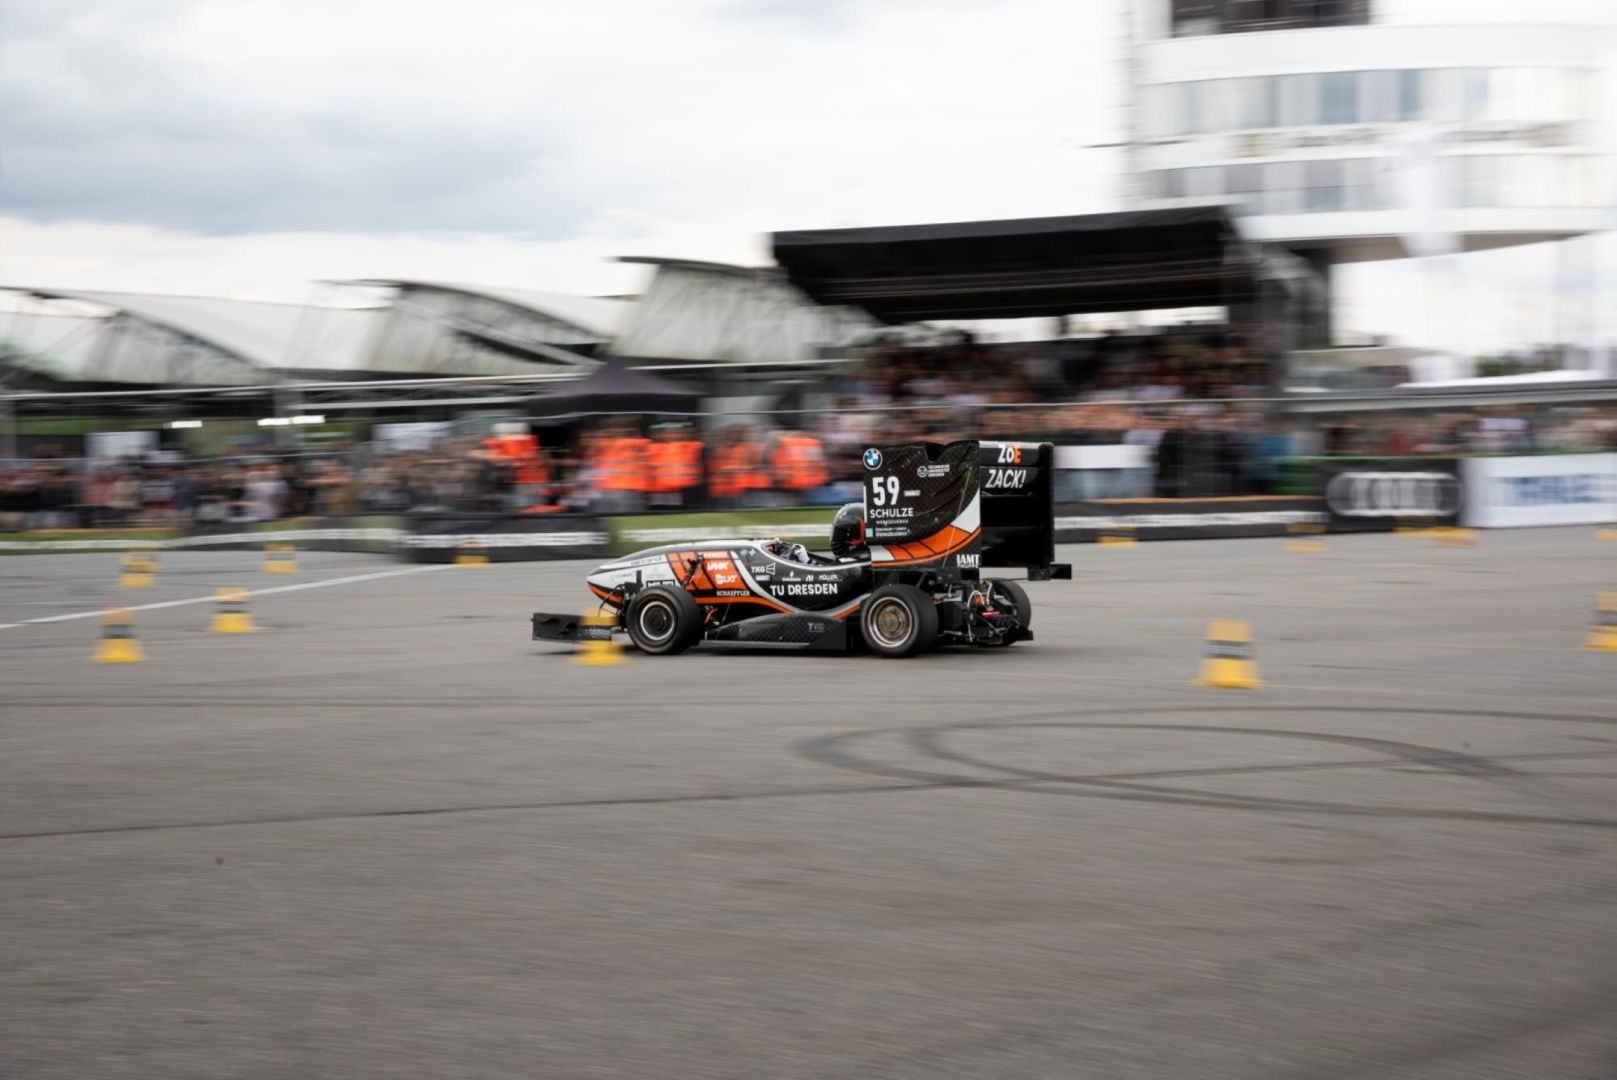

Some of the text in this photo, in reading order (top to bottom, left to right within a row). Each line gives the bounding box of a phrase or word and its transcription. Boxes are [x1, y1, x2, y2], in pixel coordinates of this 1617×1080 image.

[985, 469, 1027, 489] ZACK!
[872, 476, 900, 506] 59
[869, 507, 914, 519] SCHULZE
[770, 583, 838, 596] TU DRESDEN
